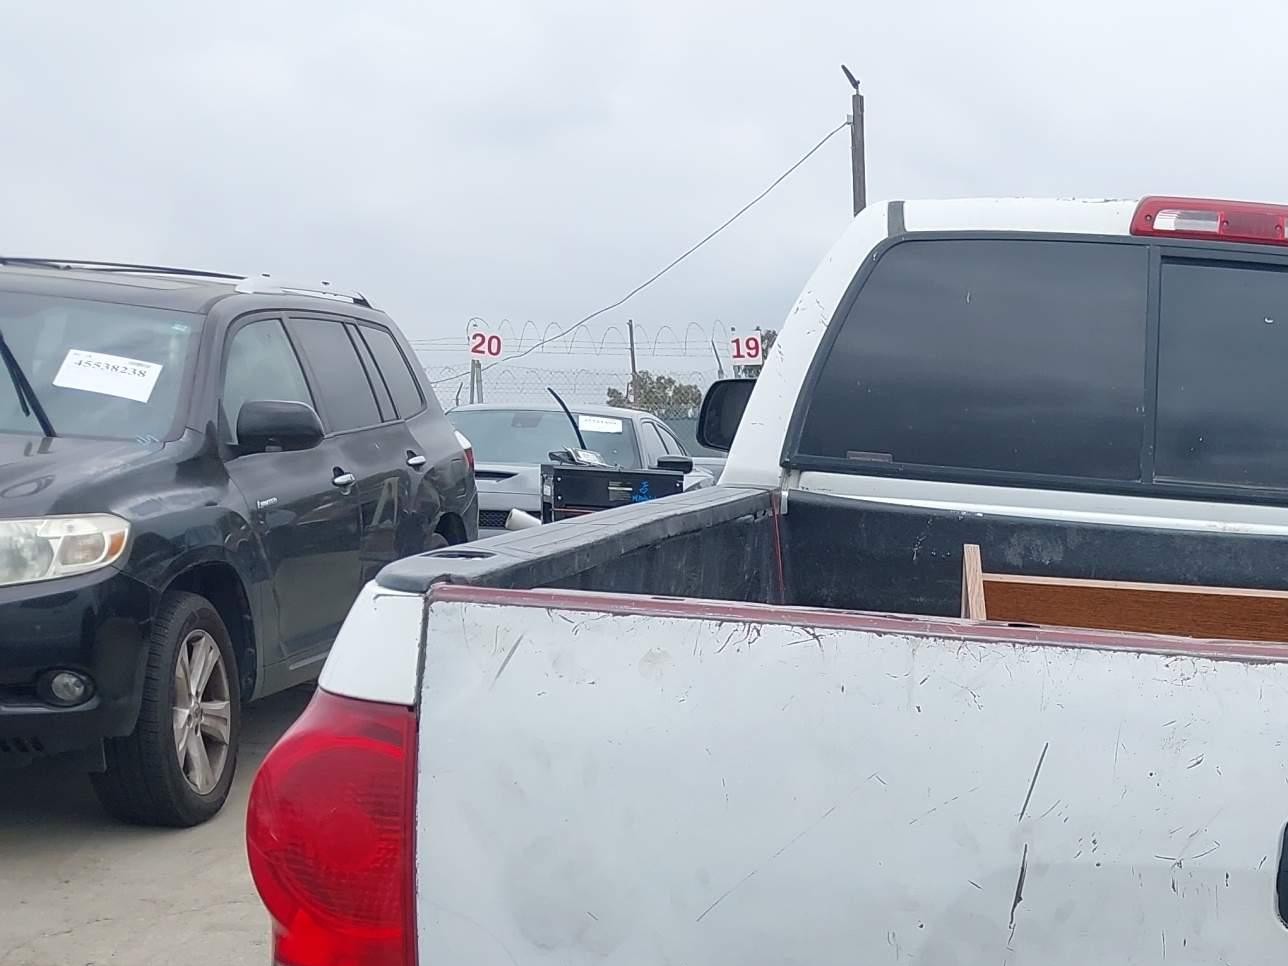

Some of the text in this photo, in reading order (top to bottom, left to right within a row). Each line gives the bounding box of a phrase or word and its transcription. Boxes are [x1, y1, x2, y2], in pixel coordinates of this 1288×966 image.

[471, 333, 502, 356] 20
[731, 337, 760, 359] 19
[73, 360, 148, 378] 45538238
